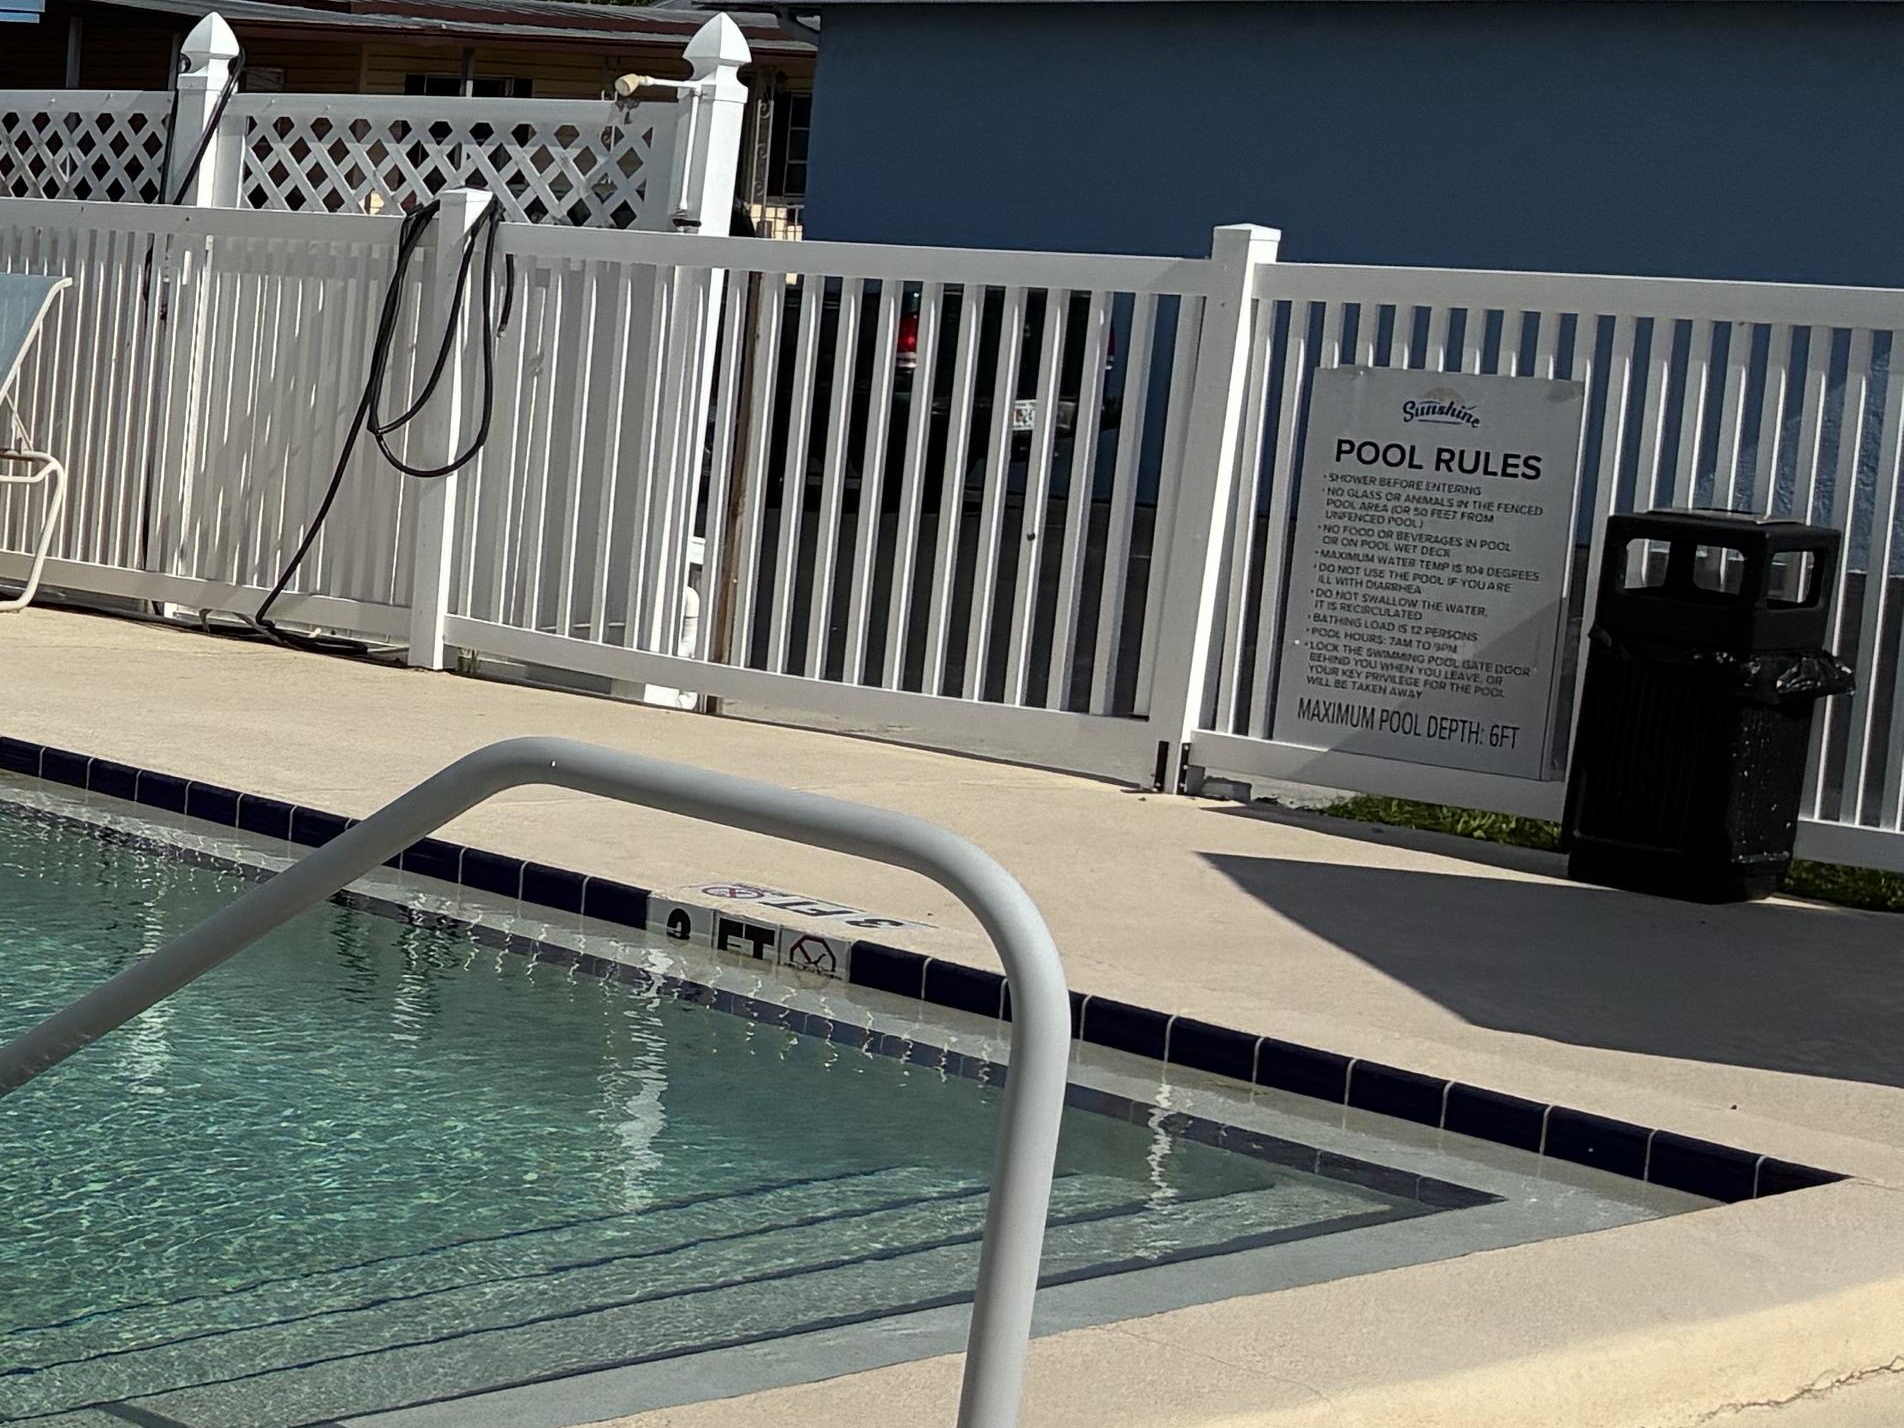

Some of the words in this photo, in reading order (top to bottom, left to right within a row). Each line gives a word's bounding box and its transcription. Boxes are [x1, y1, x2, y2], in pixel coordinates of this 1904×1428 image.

[1403, 400, 1480, 428] Sunshine
[1336, 439, 1424, 469] POOL
[1435, 448, 1542, 479] RULES
[1329, 473, 1376, 486] SHOWER
[1379, 477, 1423, 490] BEFORE
[1425, 481, 1482, 495] ENTERING
[1326, 498, 1356, 509] POOL
[1360, 501, 1388, 512] AREA
[1413, 507, 1427, 516] 50
[1430, 508, 1456, 519] FEET
[1460, 511, 1493, 523] FROM
[1327, 486, 1344, 497] NO
[1347, 488, 1382, 500] GLASS
[1385, 492, 1400, 502] OR
[1404, 494, 1453, 507] ANIMALS
[1456, 498, 1468, 508] IN
[1472, 500, 1493, 511] THE
[1497, 502, 1543, 516] FENCED
[1325, 510, 1384, 524] UNFENCED
[1388, 516, 1423, 528] POOL)
[1322, 535, 1337, 545] OR
[1340, 537, 1357, 547] ON
[1360, 539, 1389, 551] POOL
[1393, 543, 1417, 554] WET
[1420, 545, 1450, 557] DECK
[1323, 523, 1340, 533] NO
[1343, 525, 1374, 537] FOOD
[1377, 529, 1392, 539] OR
[1396, 531, 1462, 546] BEVERAGES
[1465, 538, 1476, 548] IN
[1480, 539, 1512, 551] POOL
[1318, 562, 1335, 572] DO
[1338, 564, 1360, 575] NOT
[1364, 567, 1384, 578] USE
[1389, 570, 1409, 581] THE
[1412, 573, 1444, 585] POOL
[1447, 576, 1459, 586] IF
[1320, 549, 1374, 563] MAXIMUM
[1378, 555, 1415, 567] WATER
[1420, 559, 1449, 571] TEMP
[1451, 563, 1462, 572] IS
[1486, 567, 1539, 581] DEGREES
[1317, 574, 1331, 584] ILL
[1335, 576, 1361, 587] WITH
[1365, 580, 1421, 594] DIARRHEA
[1315, 599, 1324, 608] IT
[1327, 601, 1336, 610] IS
[1339, 602, 1422, 620] RECIRCULATED
[1316, 587, 1332, 598] DO
[1335, 590, 1358, 601] NOT
[1361, 593, 1418, 608] SWALLOW
[1421, 600, 1443, 611] THE
[1311, 627, 1340, 638] POOL
[1344, 631, 1385, 644] HOURS:
[1389, 637, 1412, 647] 7AM
[1416, 640, 1431, 650] TO
[1313, 613, 1362, 627] BATHING
[1365, 619, 1395, 632] LOAD
[1398, 623, 1407, 633] IS
[1410, 625, 1421, 635] 12
[1424, 626, 1478, 642] PERSONS
[1309, 652, 1350, 666] BEHIND
[1353, 658, 1377, 669] YOU
[1380, 661, 1413, 674] WHEN
[1416, 666, 1441, 678] YOU
[1485, 675, 1503, 686] OR
[1310, 640, 1339, 652] LOCK
[1343, 644, 1363, 655] THE
[1366, 647, 1425, 663] SWIMMING
[1428, 655, 1459, 668] POOL
[1462, 660, 1492, 672] GATE
[1495, 664, 1529, 677] DOOR
[1306, 675, 1331, 686] WILL
[1334, 679, 1347, 689] BE
[1351, 681, 1386, 694] TAKEN
[1389, 687, 1422, 699] AWAY
[1307, 663, 1339, 676] YOUR
[1342, 668, 1362, 679] KEY
[1365, 671, 1420, 687] PRIVILEGE
[1423, 679, 1446, 691] FOR
[1449, 682, 1471, 694] THE
[1473, 686, 1504, 698] POOL
[1298, 697, 1373, 728] MAXIMUM
[1380, 709, 1422, 735] POOL
[1427, 716, 1484, 745] DEPTH:
[1489, 724, 1518, 750] 6FT
